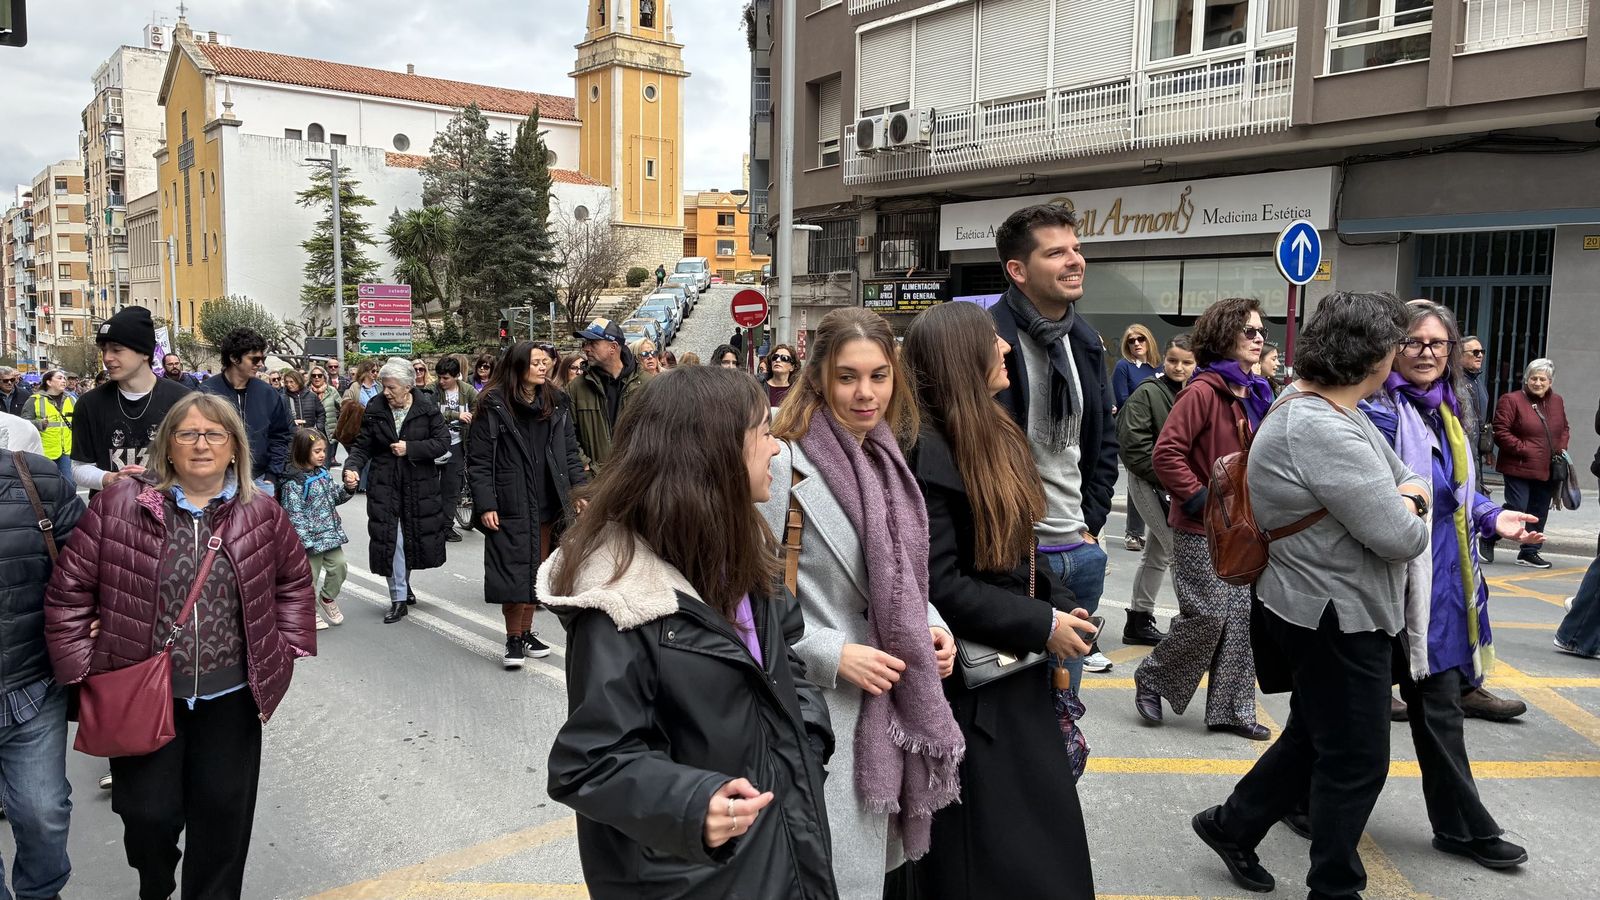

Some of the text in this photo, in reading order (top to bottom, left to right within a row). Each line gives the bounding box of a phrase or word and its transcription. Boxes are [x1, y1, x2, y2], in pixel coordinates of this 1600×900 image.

[1203, 204, 1312, 225] Medicina Estética
[955, 226, 985, 241] Estética
[1586, 237, 1598, 246] 20
[901, 282, 940, 290] ALIMENTACIÓN
[913, 292, 936, 300] GENERAL
